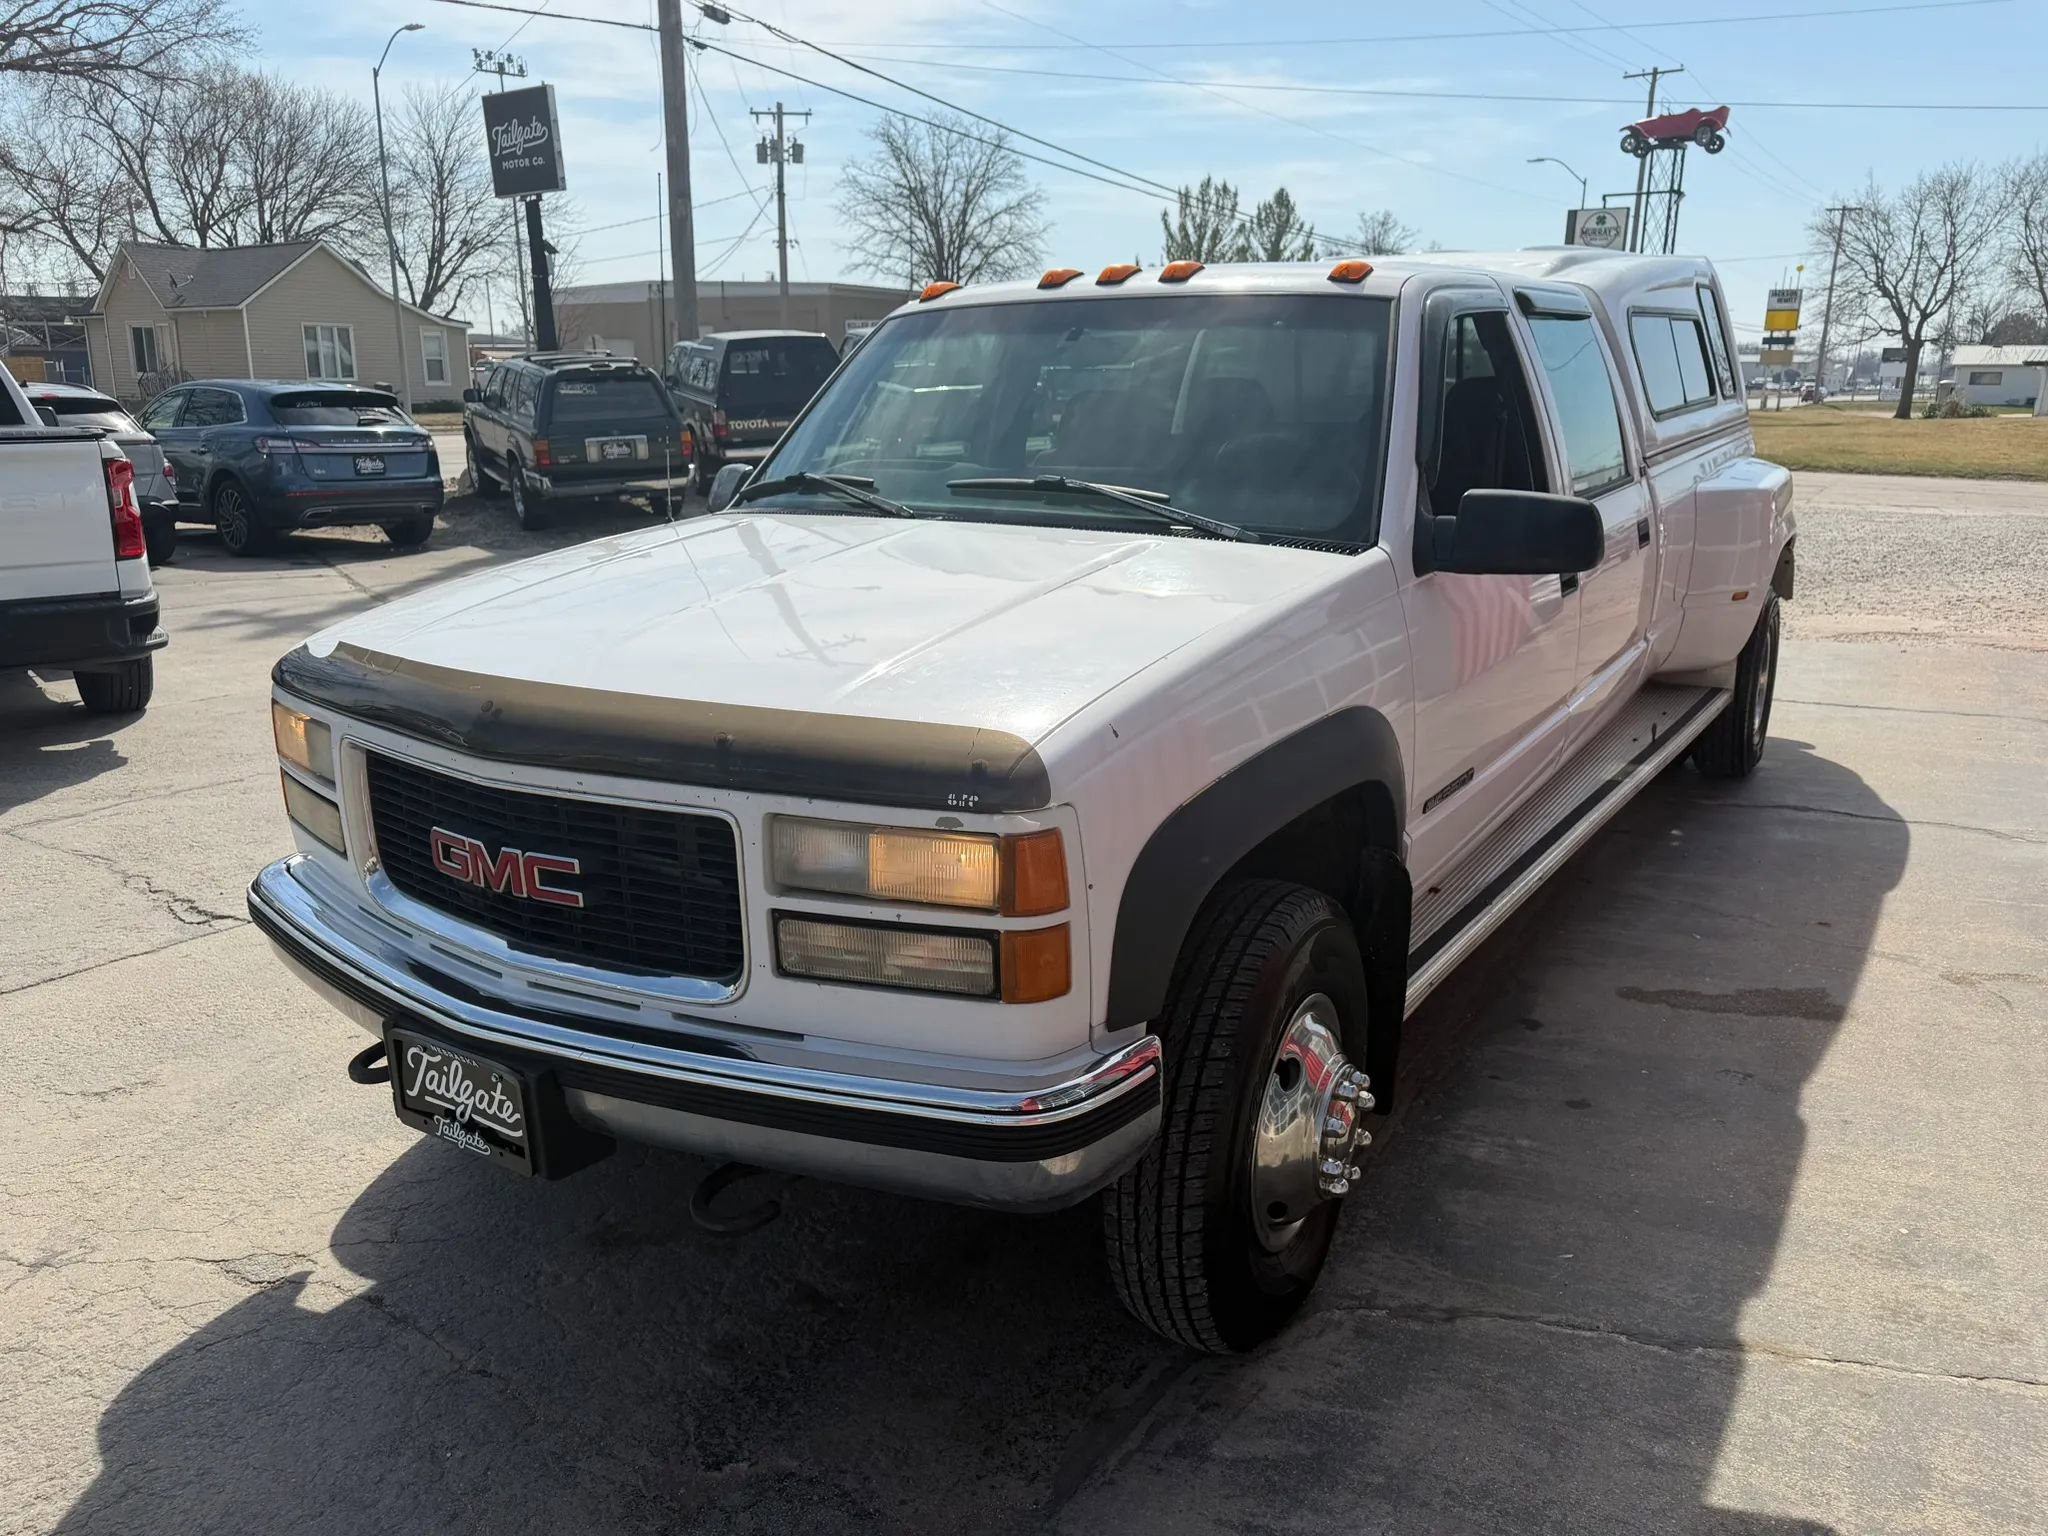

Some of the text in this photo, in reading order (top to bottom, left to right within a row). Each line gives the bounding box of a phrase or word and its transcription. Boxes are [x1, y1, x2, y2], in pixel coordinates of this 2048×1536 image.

[492, 115, 548, 156] Tailgate
[502, 159, 530, 170] MOTOR
[1581, 226, 1621, 238] MURRAY'S
[729, 419, 770, 430] TOYOTA
[430, 826, 584, 908] GMC
[430, 1045, 479, 1068] NEBRASKA
[406, 1046, 524, 1137] Tailgate
[433, 1115, 491, 1156] Tailgate
